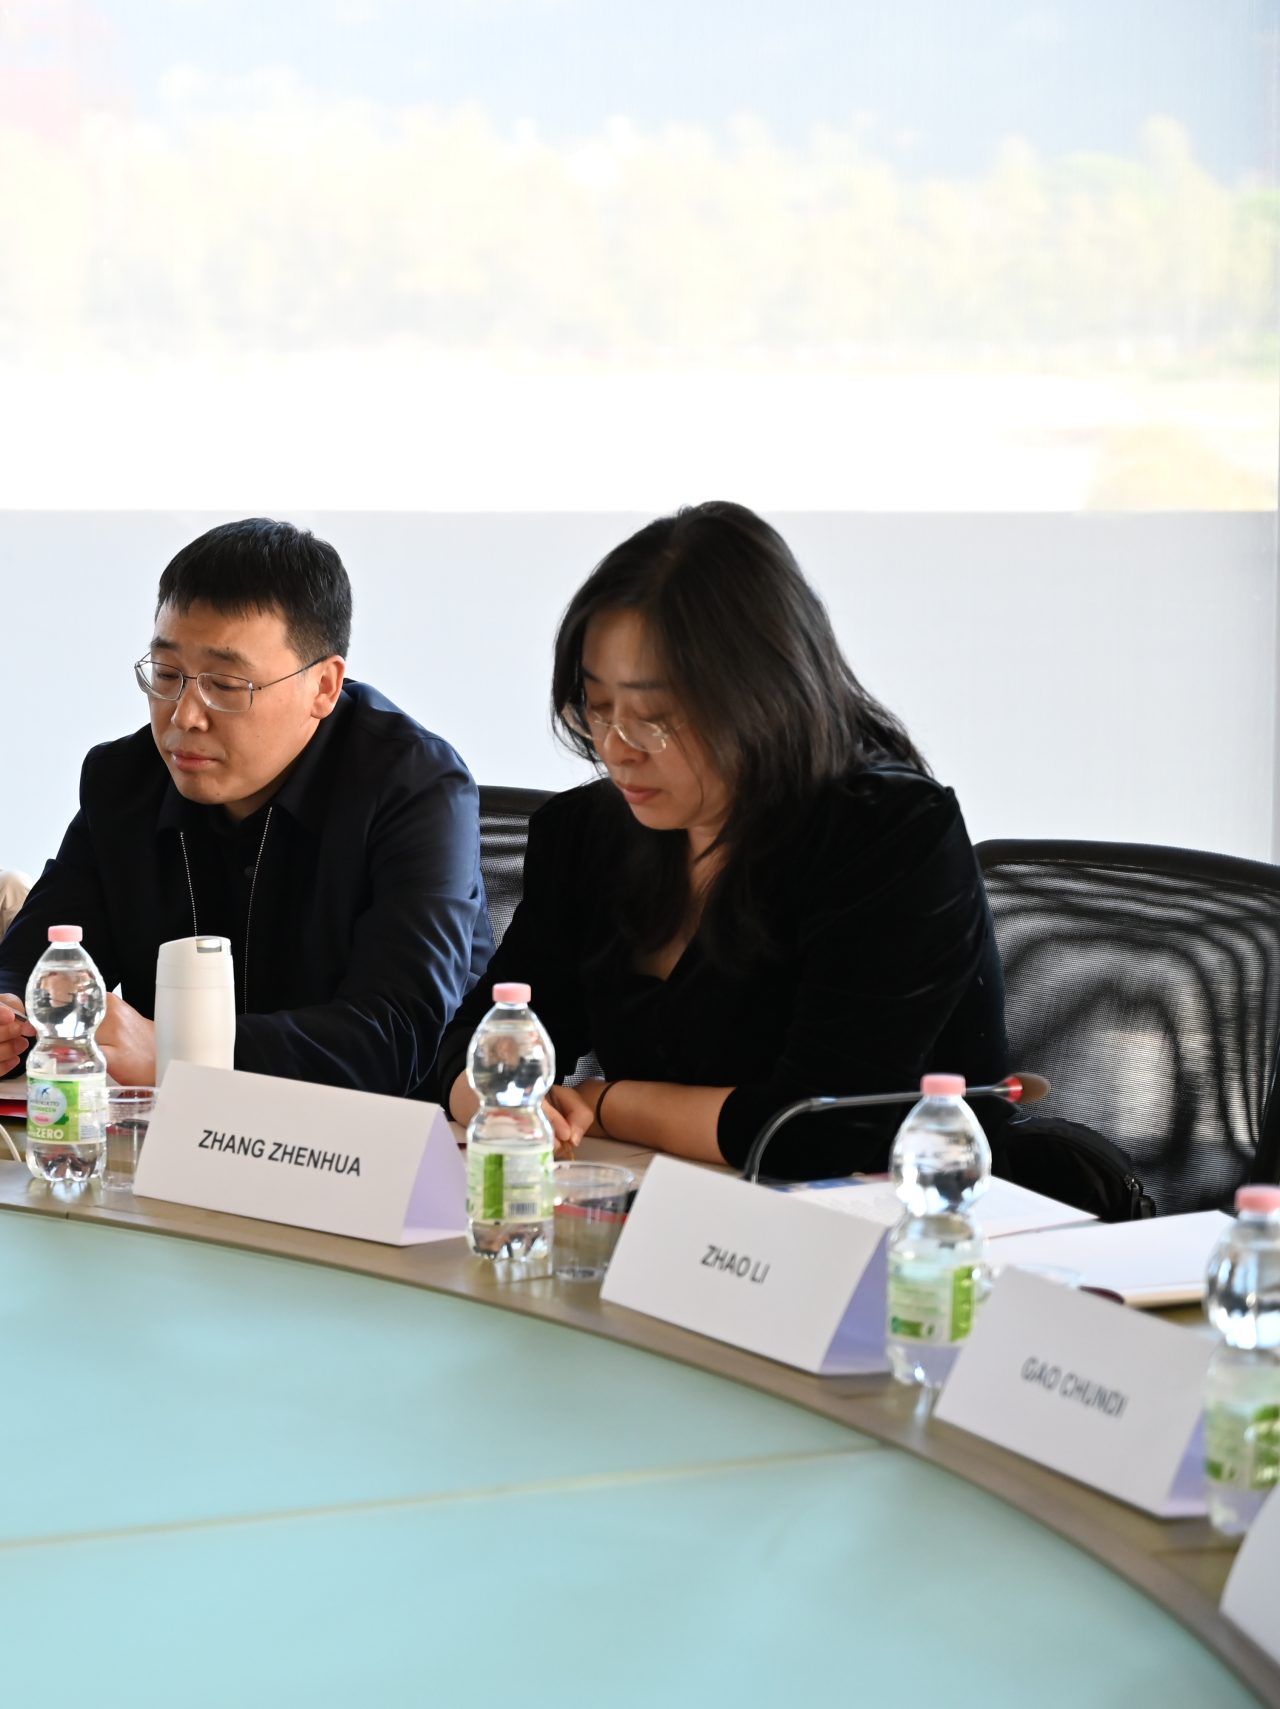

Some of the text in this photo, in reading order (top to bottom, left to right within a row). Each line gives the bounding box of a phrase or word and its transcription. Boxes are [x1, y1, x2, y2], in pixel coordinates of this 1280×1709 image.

[36, 1127, 64, 1140] ZERO
[198, 1129, 360, 1177] ZHANG ZHENHUA
[701, 1245, 770, 1285] ZHAO LI
[1021, 1356, 1062, 1391] GAO
